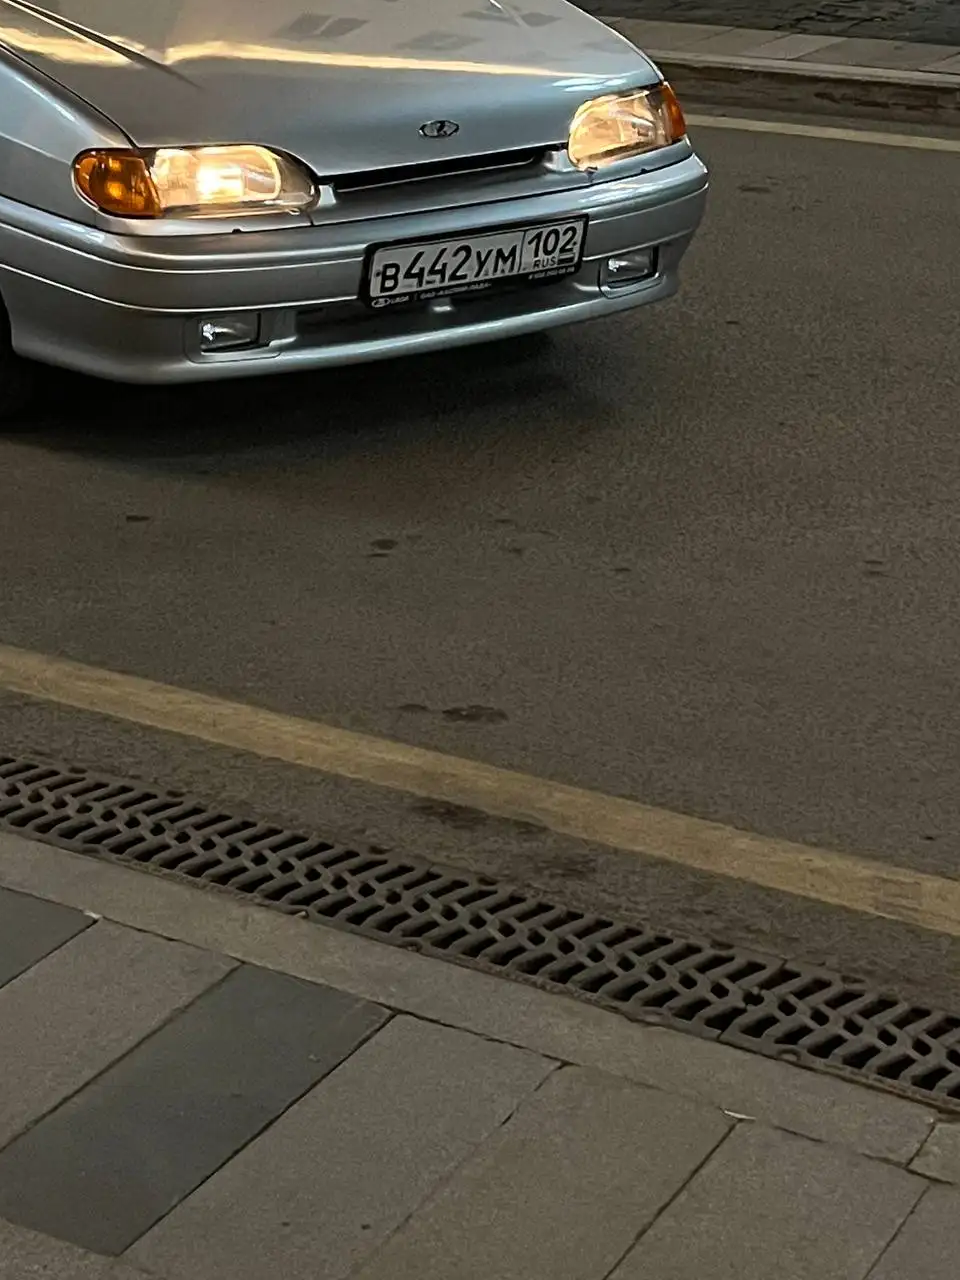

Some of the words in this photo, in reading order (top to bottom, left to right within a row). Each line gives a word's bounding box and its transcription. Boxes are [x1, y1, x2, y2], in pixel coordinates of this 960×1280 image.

[380, 244, 518, 293] В442УМ
[527, 226, 577, 258] 102
[533, 255, 558, 270] RUS
